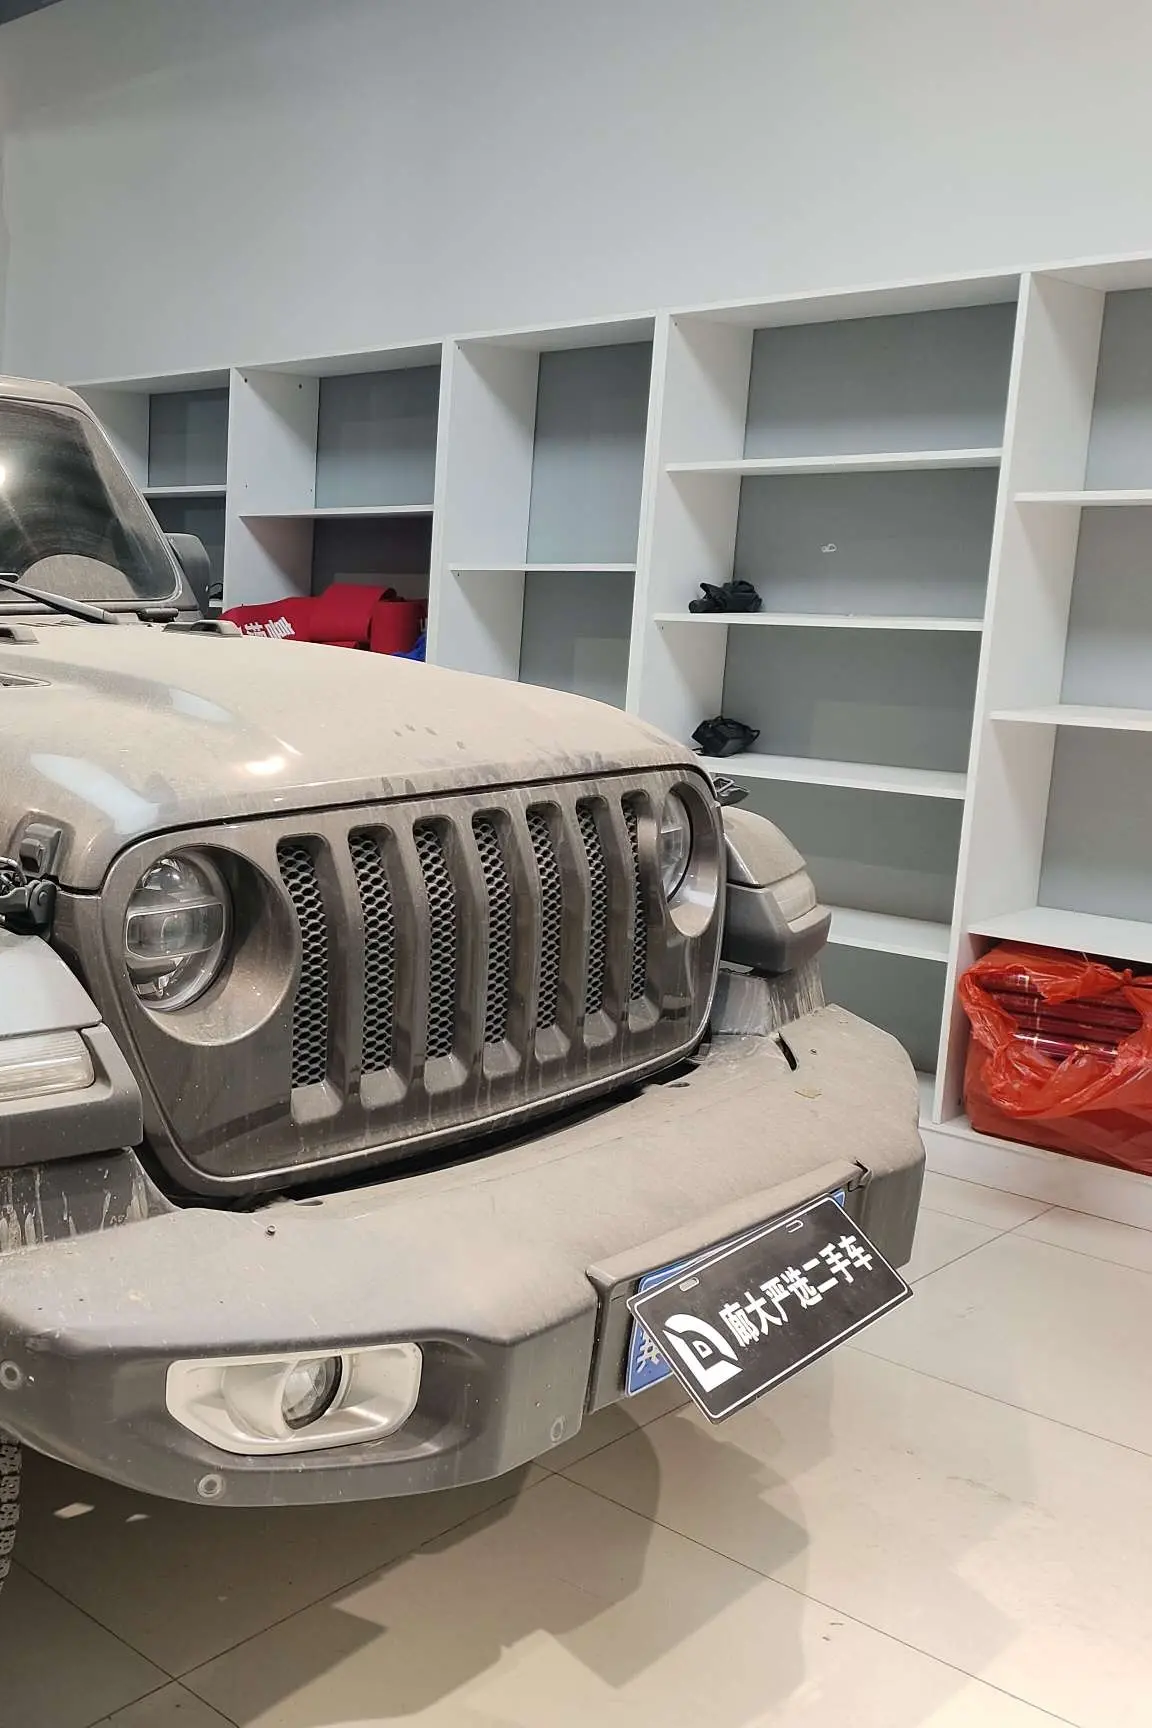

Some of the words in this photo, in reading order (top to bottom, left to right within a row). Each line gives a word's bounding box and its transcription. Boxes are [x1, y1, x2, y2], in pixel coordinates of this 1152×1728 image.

[718, 1235, 874, 1348] 廊大严选二手车
